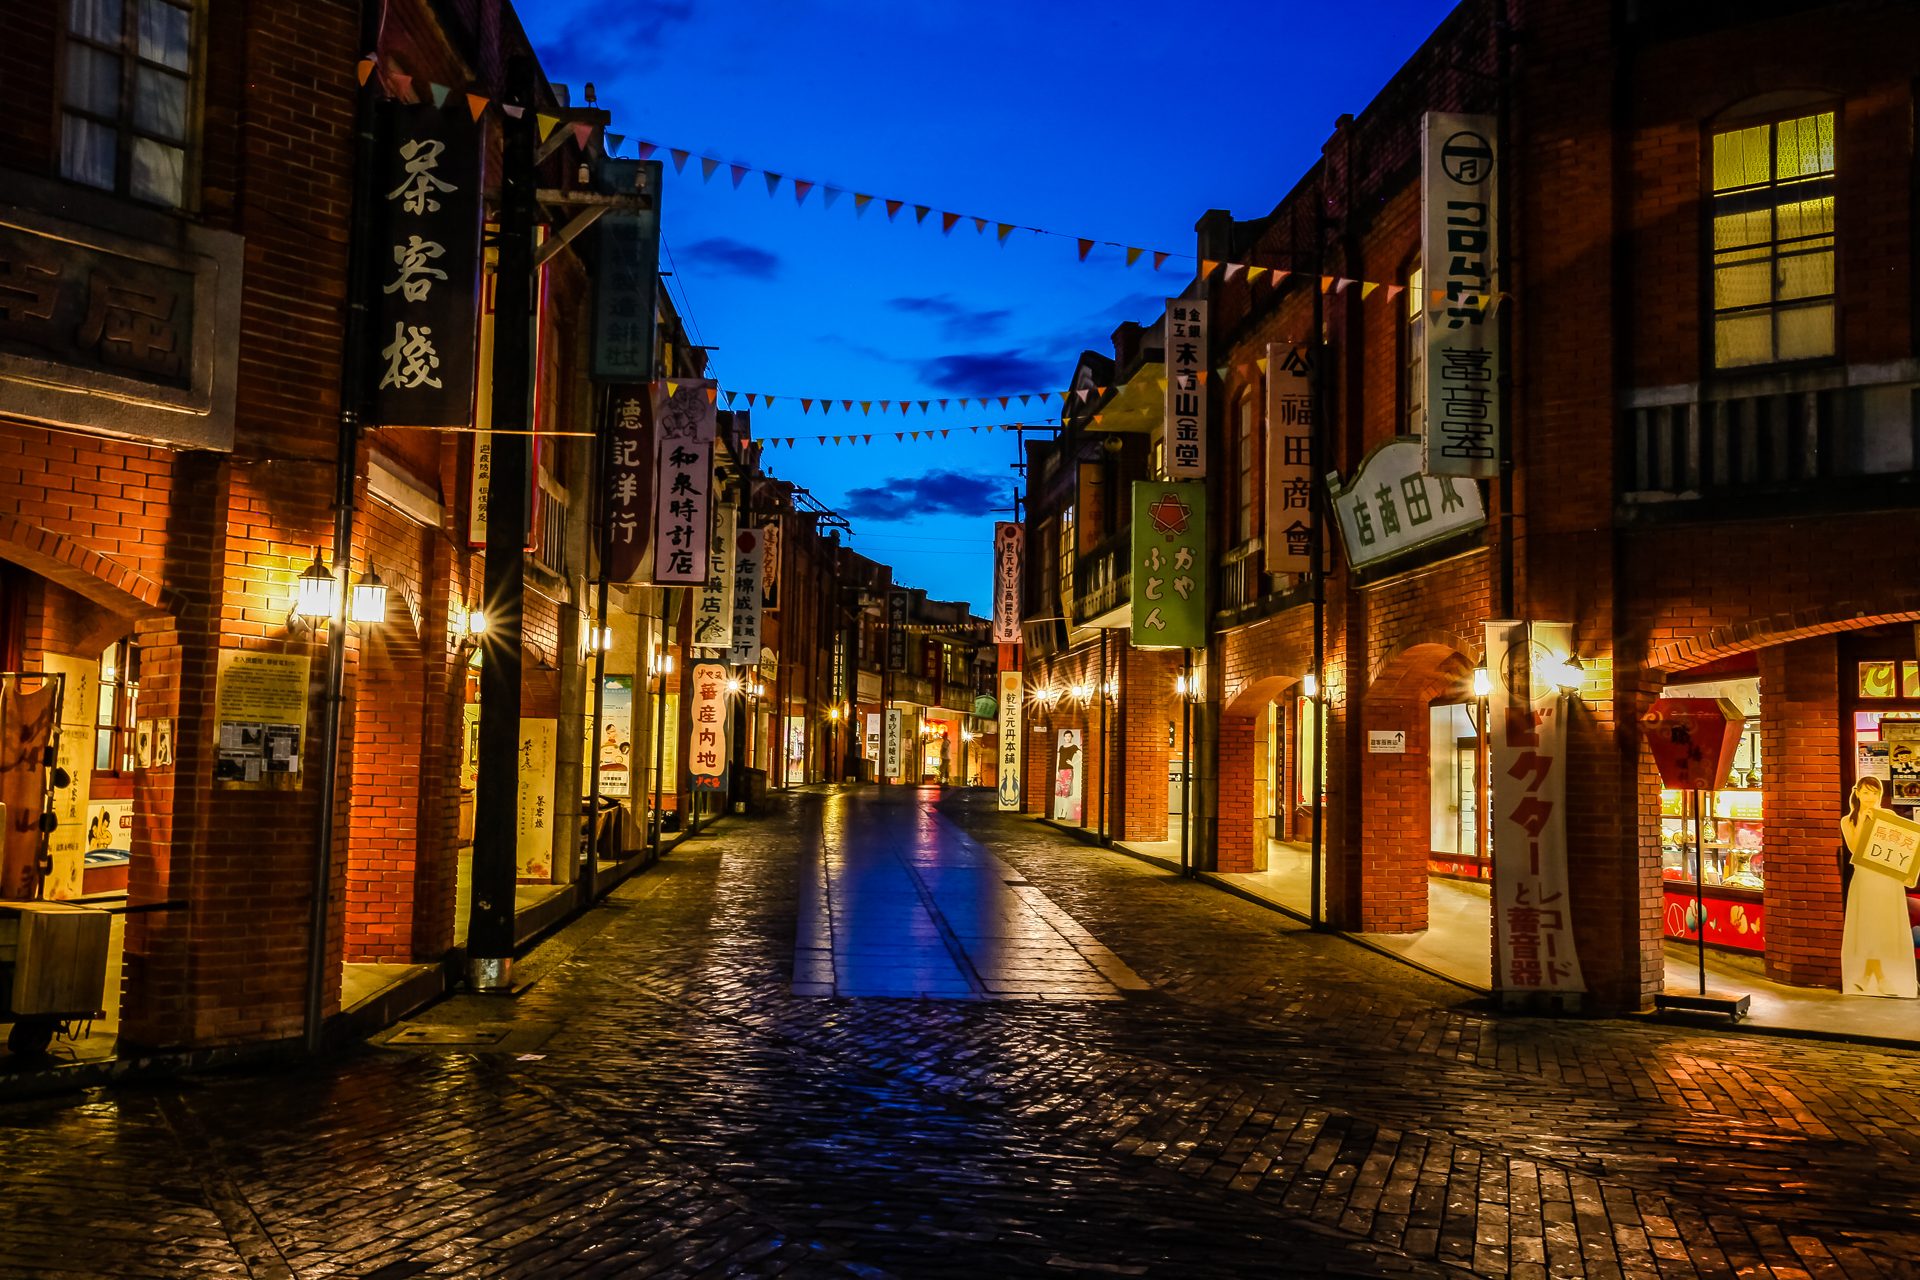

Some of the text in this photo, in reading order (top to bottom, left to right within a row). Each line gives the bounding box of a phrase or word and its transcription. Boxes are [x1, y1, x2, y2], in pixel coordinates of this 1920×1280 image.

[379, 138, 459, 389] 茶客棧
[665, 446, 702, 575] 和泉時計店
[1144, 547, 1166, 631] ふとん
[1173, 547, 1196, 601] かや
[1504, 706, 1553, 876] ビクター
[1870, 843, 1910, 867] DIY
[1873, 826, 1916, 851] 馬賽克
[1538, 883, 1573, 985] レコード
